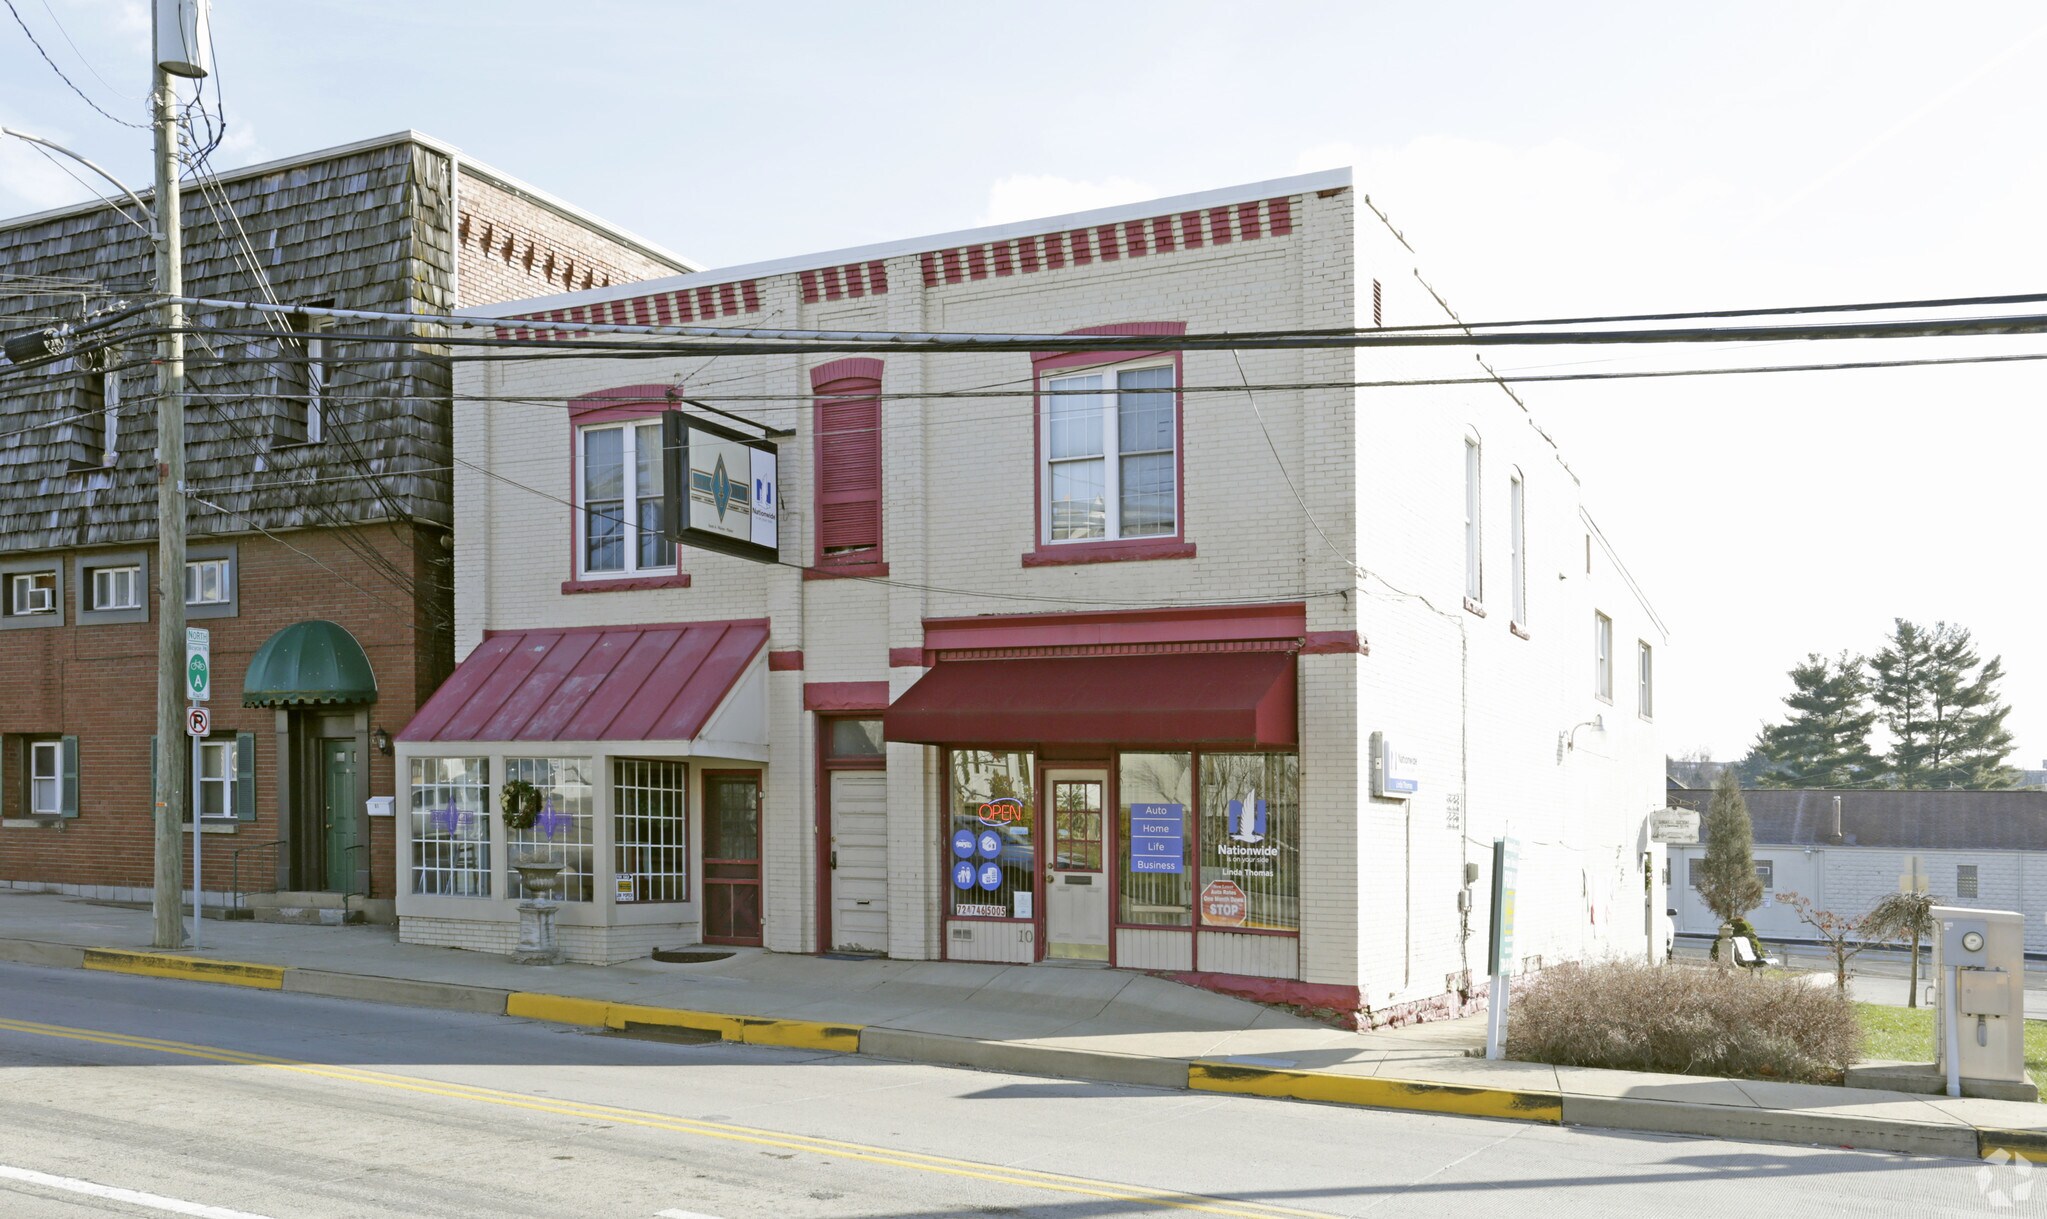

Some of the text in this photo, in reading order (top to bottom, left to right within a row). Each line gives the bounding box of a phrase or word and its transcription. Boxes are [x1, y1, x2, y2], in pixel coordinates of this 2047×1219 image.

[752, 507, 776, 520] Nationwide
[188, 630, 208, 640] NORTH
[194, 674, 203, 688] A
[193, 713, 203, 729] P
[979, 803, 1022, 821] OPEN
[1145, 806, 1168, 815] Auto
[1142, 824, 1170, 833] Home
[1148, 842, 1165, 851] Life
[1217, 844, 1278, 856] Nationwide
[1137, 860, 1176, 870] Business
[1222, 868, 1274, 877] Linda Thomas
[1209, 903, 1239, 916] STOP
[1018, 930, 1033, 943] 10
